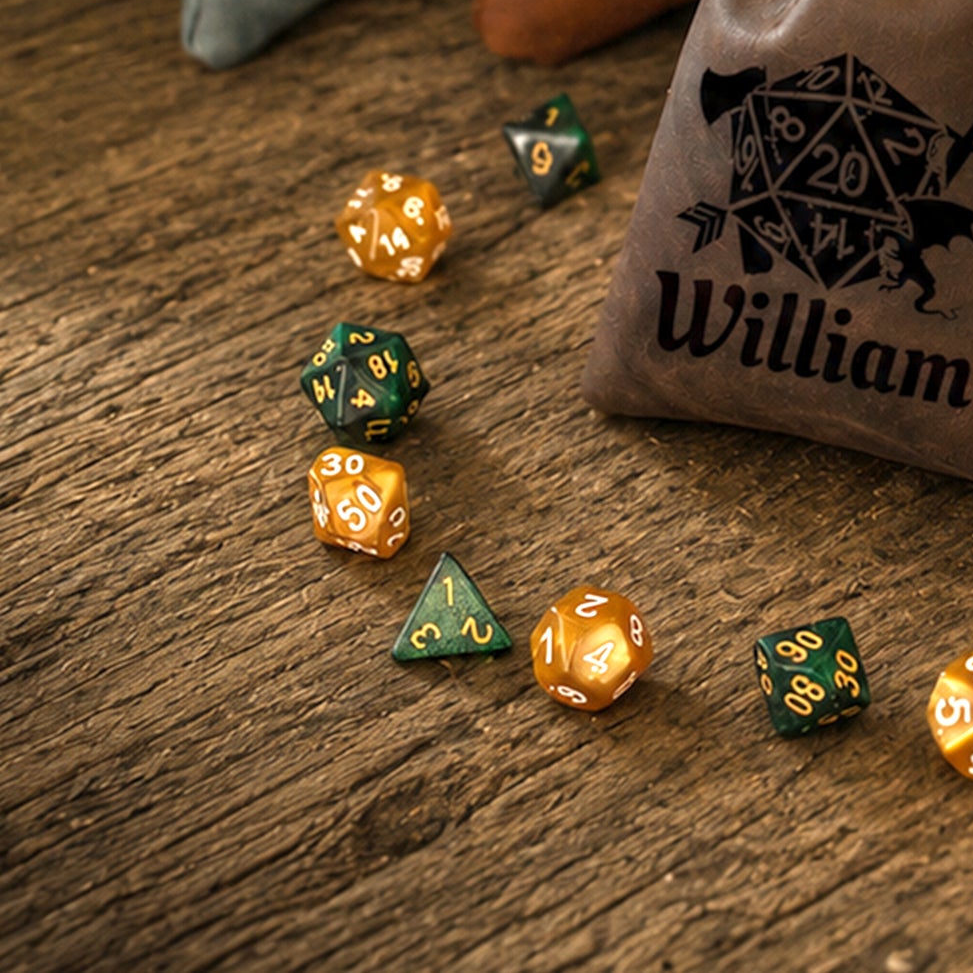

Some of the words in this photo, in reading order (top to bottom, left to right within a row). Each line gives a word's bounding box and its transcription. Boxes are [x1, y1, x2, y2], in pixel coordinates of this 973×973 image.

[856, 70, 893, 107] 12
[770, 105, 806, 143] 8
[806, 143, 870, 198] 20
[655, 269, 972, 410] William
[320, 452, 365, 477] 30
[335, 484, 383, 533] 50
[442, 576, 454, 607] 1
[409, 622, 443, 650] 3
[461, 615, 494, 645] 2
[539, 625, 553, 665] 1
[629, 613, 644, 648] 8
[774, 630, 825, 664] 90
[581, 641, 615, 675] 4
[833, 648, 860, 699] 30
